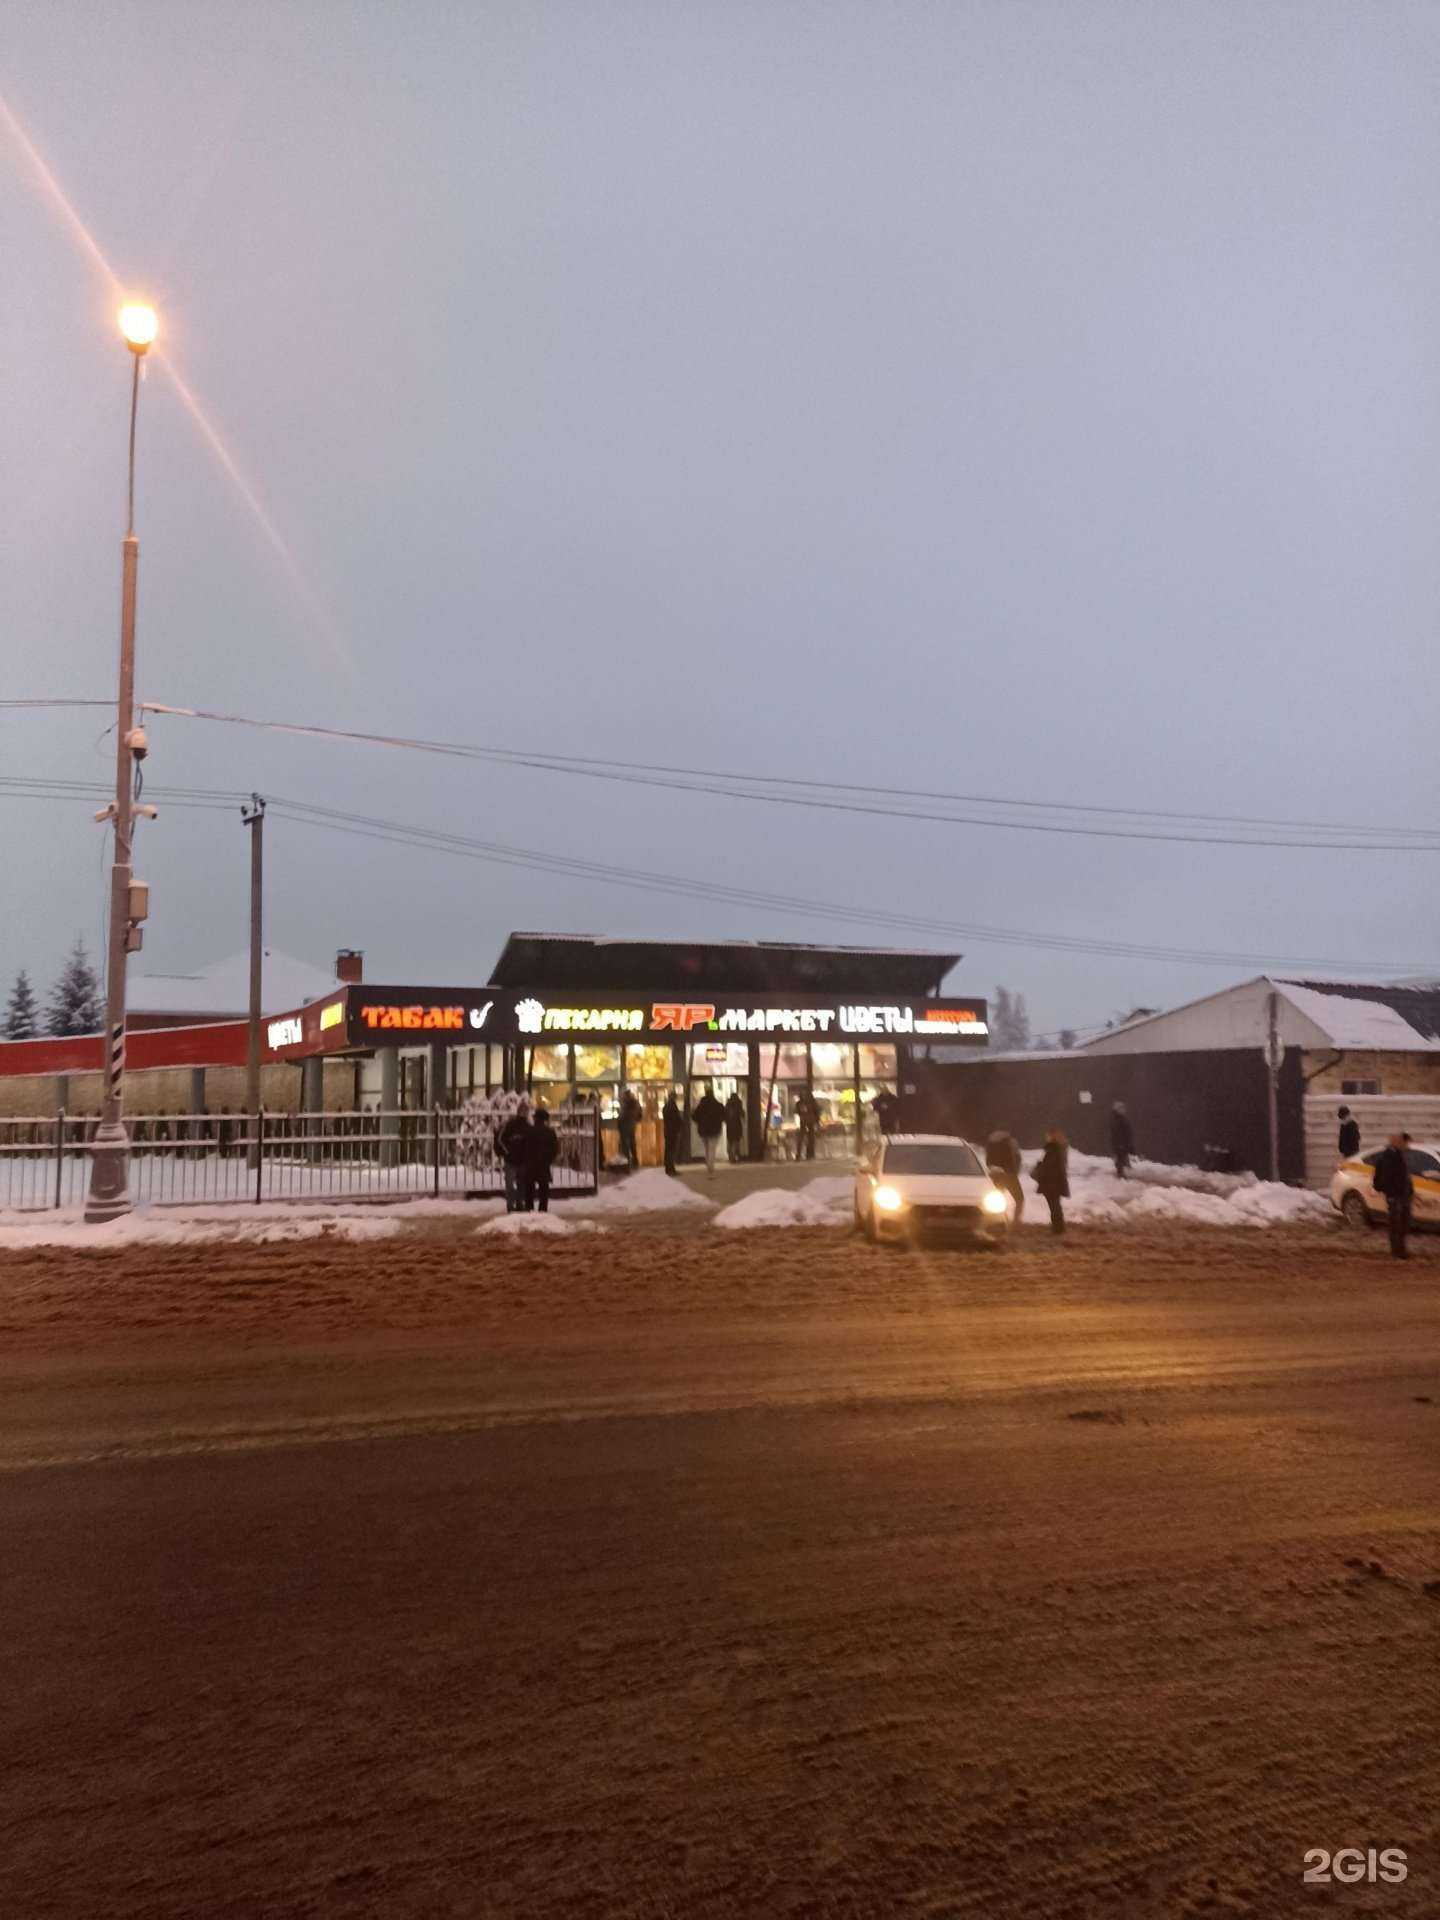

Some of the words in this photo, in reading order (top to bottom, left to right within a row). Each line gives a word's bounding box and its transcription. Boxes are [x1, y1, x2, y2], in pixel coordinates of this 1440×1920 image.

[361, 1006, 464, 1029] ТАБАК
[544, 1008, 644, 1030] ПЕКАРНЯ
[839, 1005, 914, 1033] ЦВЕТЫ
